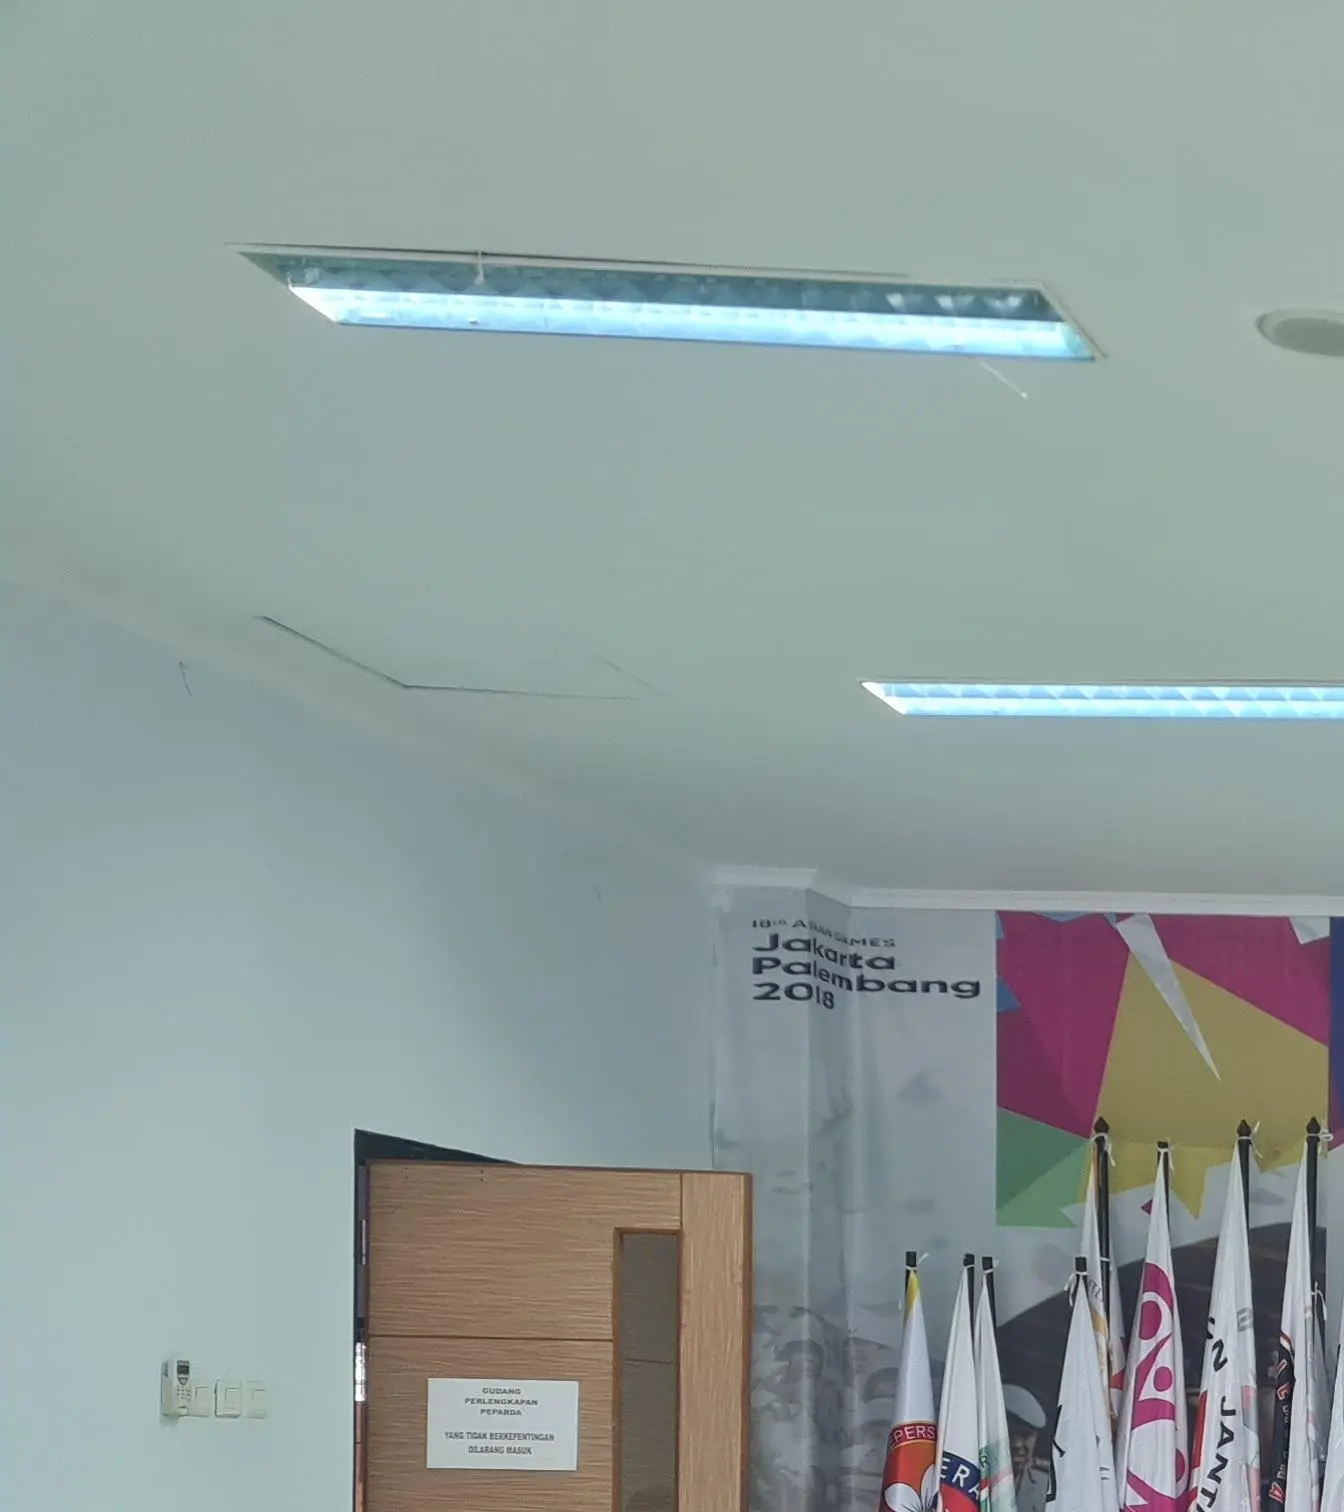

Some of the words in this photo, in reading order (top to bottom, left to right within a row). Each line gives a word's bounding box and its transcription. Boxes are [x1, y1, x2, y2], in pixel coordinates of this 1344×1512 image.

[752, 933, 895, 970] Jakarta
[752, 956, 981, 999] Palembang
[752, 982, 836, 1010] 2018
